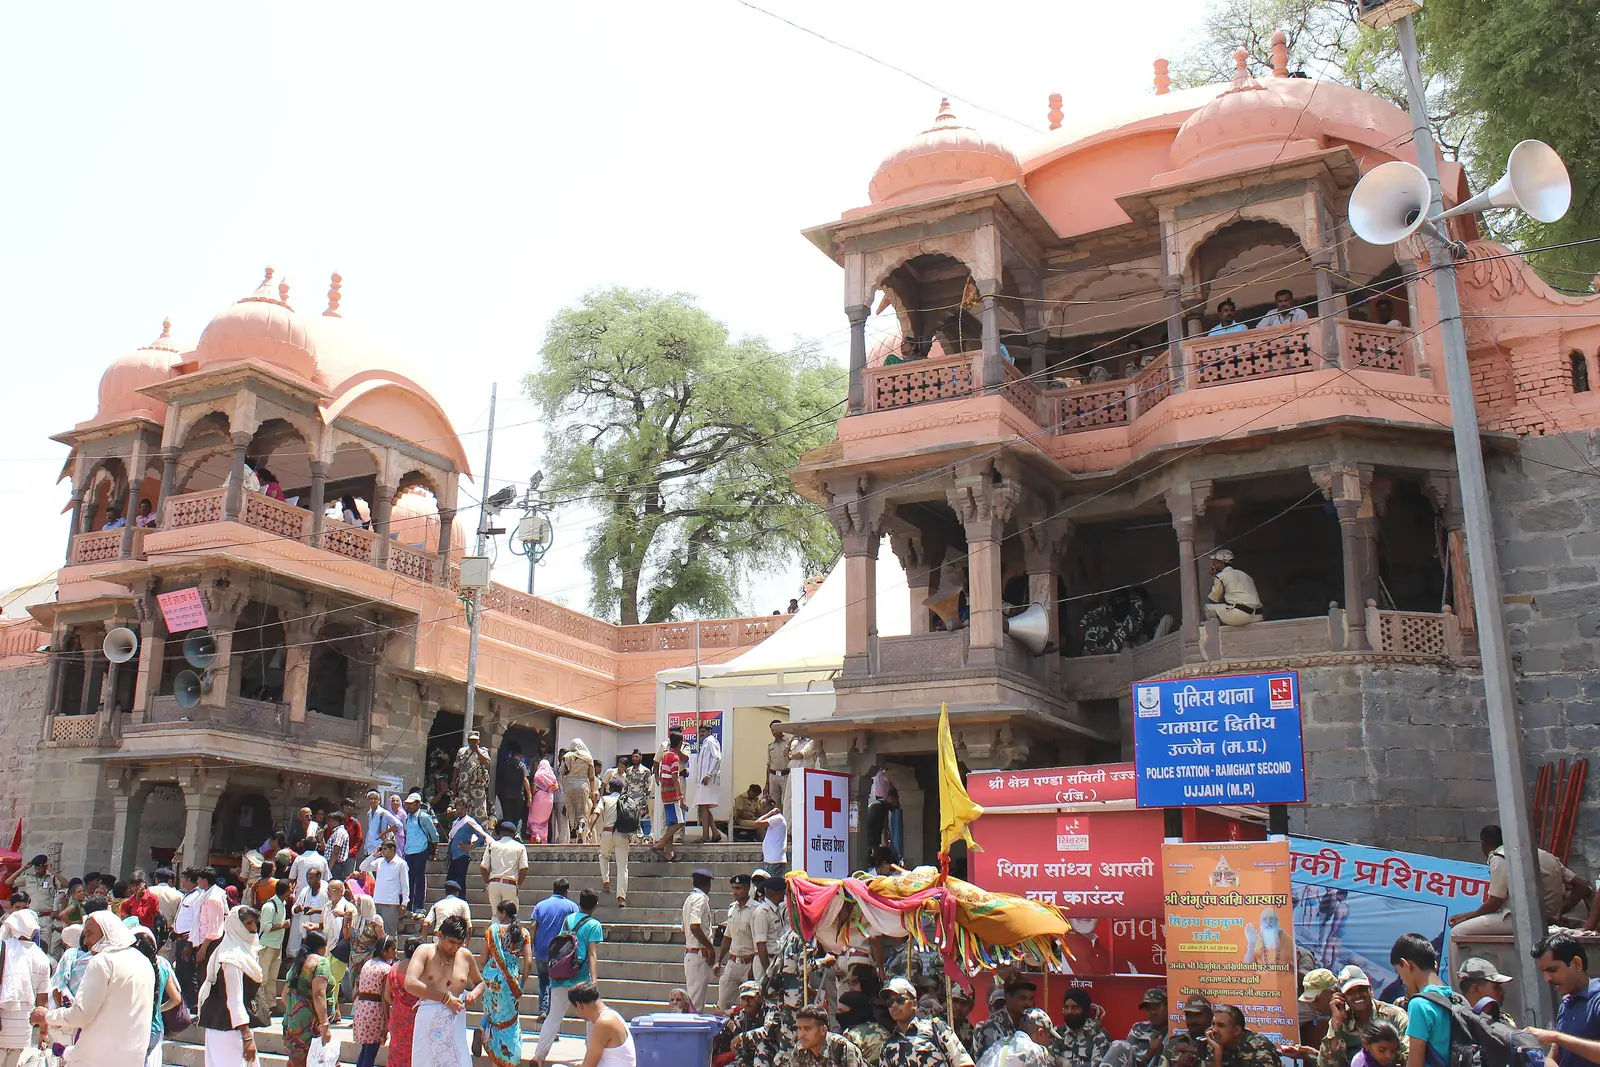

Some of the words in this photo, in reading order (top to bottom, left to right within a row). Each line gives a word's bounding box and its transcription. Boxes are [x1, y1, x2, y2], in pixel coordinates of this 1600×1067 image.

[1173, 684, 1214, 714] पुलिस
[1218, 688, 1254, 705] थाना
[1157, 720, 1218, 735] रामघाट
[1224, 713, 1276, 732] द्वितीय
[1168, 738, 1215, 756] उज्जैन
[1222, 738, 1266, 756] (म.प्र.)
[988, 776, 1004, 790] श्री
[1008, 776, 1029, 789] क्षेत्र
[1033, 775, 1063, 787] पण्डा
[1067, 769, 1107, 785] समिती
[1110, 770, 1136, 782] उज्ज
[1146, 767, 1174, 779] POLICE
[1176, 765, 1210, 778] STATION
[1215, 763, 1255, 777] RAMGHAT
[1257, 761, 1291, 775] SECOND
[1184, 784, 1224, 797] UJJAIN
[1227, 782, 1255, 798] (M.P.)
[811, 834, 821, 851] यहाँ
[822, 838, 833, 852] ब्लड
[833, 835, 845, 853] प्रेशर
[824, 856, 833, 873] एवं
[996, 858, 1038, 879] शिप्रा
[1044, 858, 1092, 878] सांध्य
[1098, 856, 1154, 877] आरती
[1353, 857, 1491, 903] प्रशिक्षण
[1063, 885, 1124, 906] काउंटर
[1164, 891, 1178, 905] श्री
[1202, 891, 1217, 905] पंच
[1244, 894, 1288, 908] आखाड़ा
